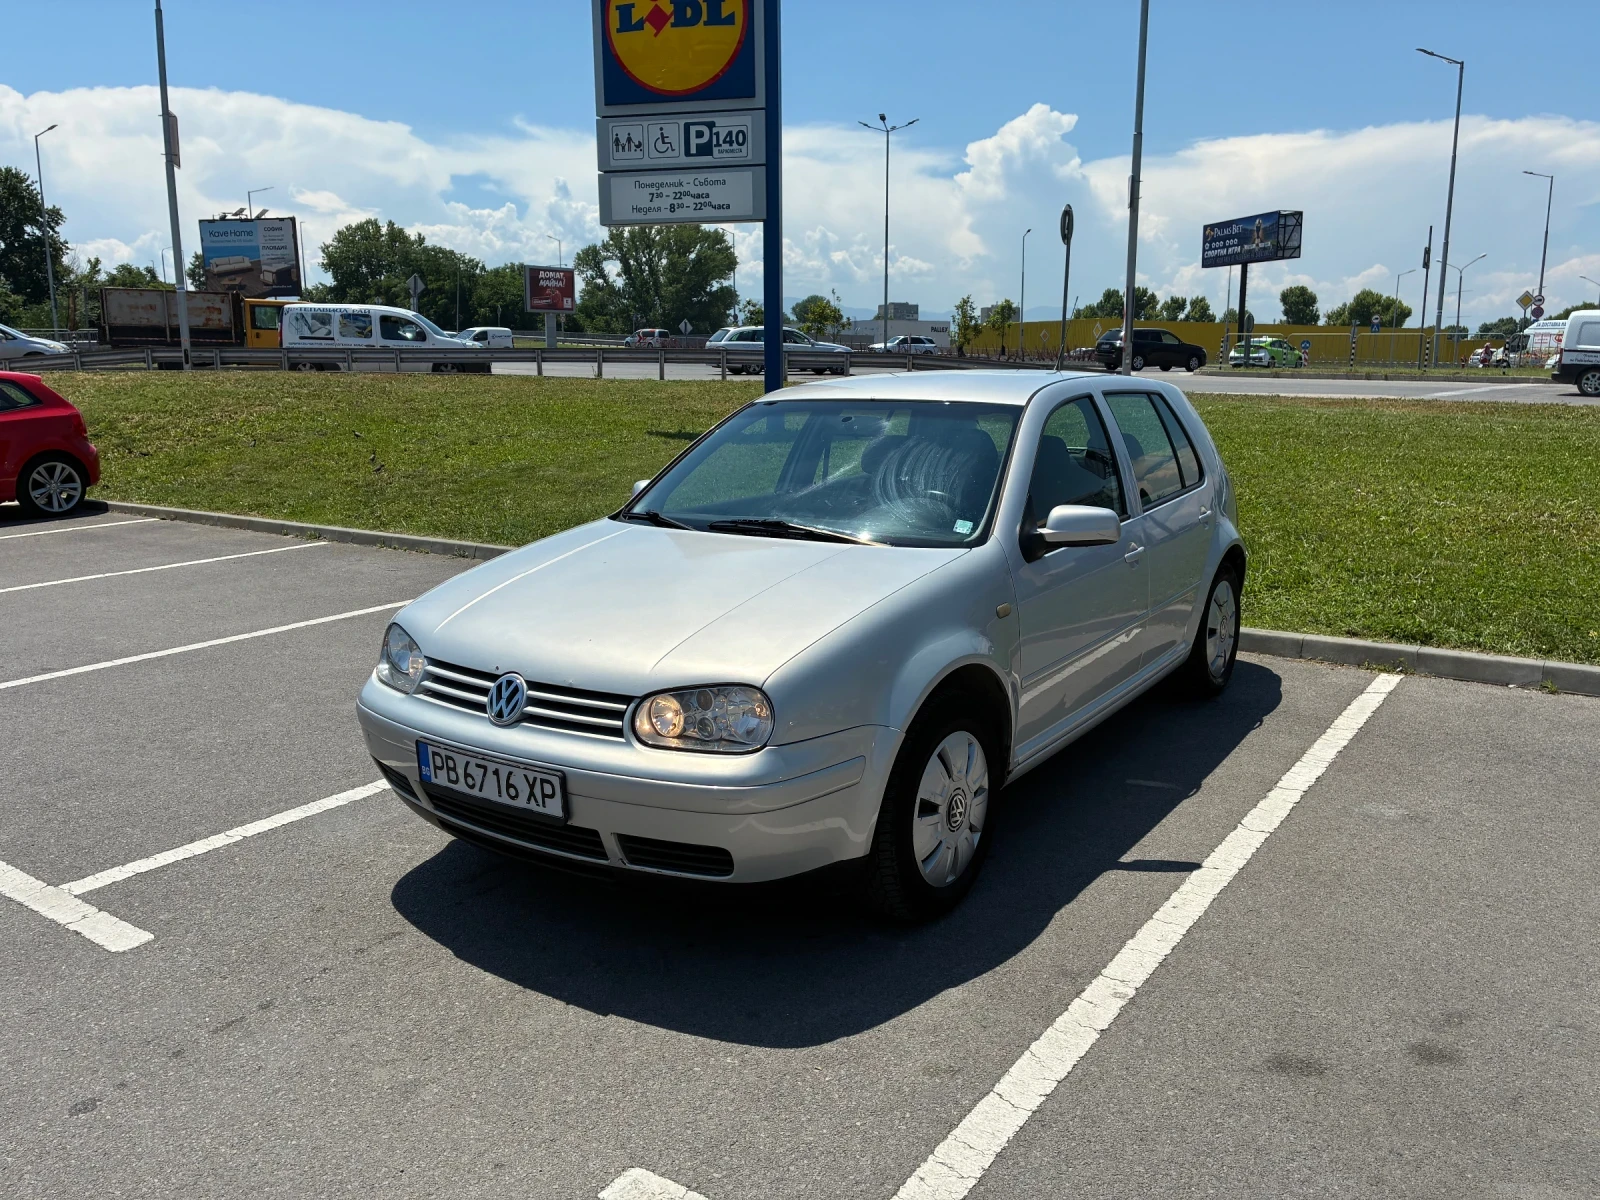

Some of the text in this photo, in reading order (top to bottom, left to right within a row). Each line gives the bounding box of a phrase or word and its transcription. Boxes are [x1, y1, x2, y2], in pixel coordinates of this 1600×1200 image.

[616, 0, 736, 38] LIDL
[713, 130, 746, 148] 140
[634, 179, 684, 190] Понеделник
[693, 178, 726, 187] Събота
[632, 204, 662, 215] Неделя
[208, 229, 253, 238] Kave Home
[1204, 248, 1226, 258] СПОРТНА
[1228, 246, 1240, 254] ИГРА
[421, 765, 431, 776] BG
